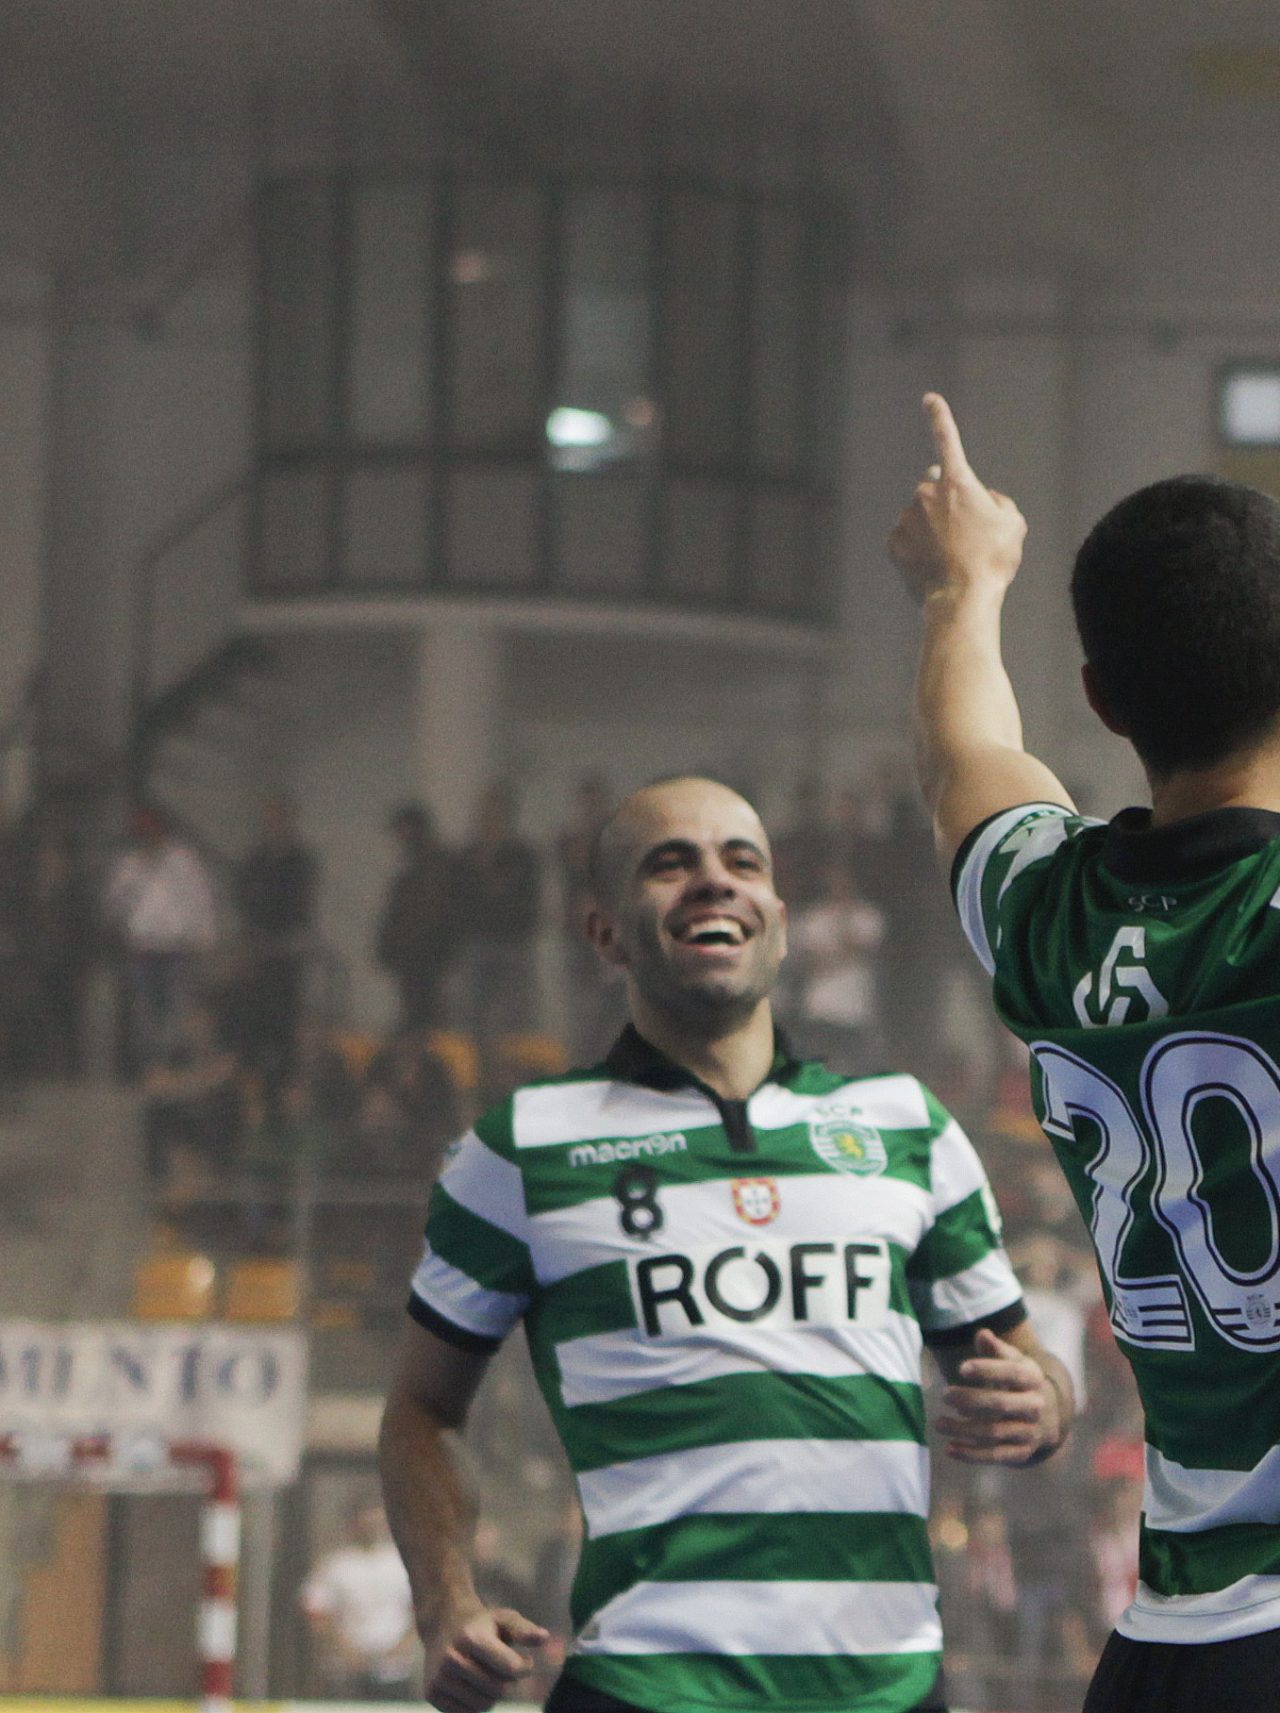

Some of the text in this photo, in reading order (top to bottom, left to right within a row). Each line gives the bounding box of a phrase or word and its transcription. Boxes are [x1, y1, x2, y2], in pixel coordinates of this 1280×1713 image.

[1128, 894, 1178, 912] SCP
[568, 1132, 688, 1169] macron
[612, 1165, 664, 1241] 8
[636, 1242, 884, 1338] ROFF
